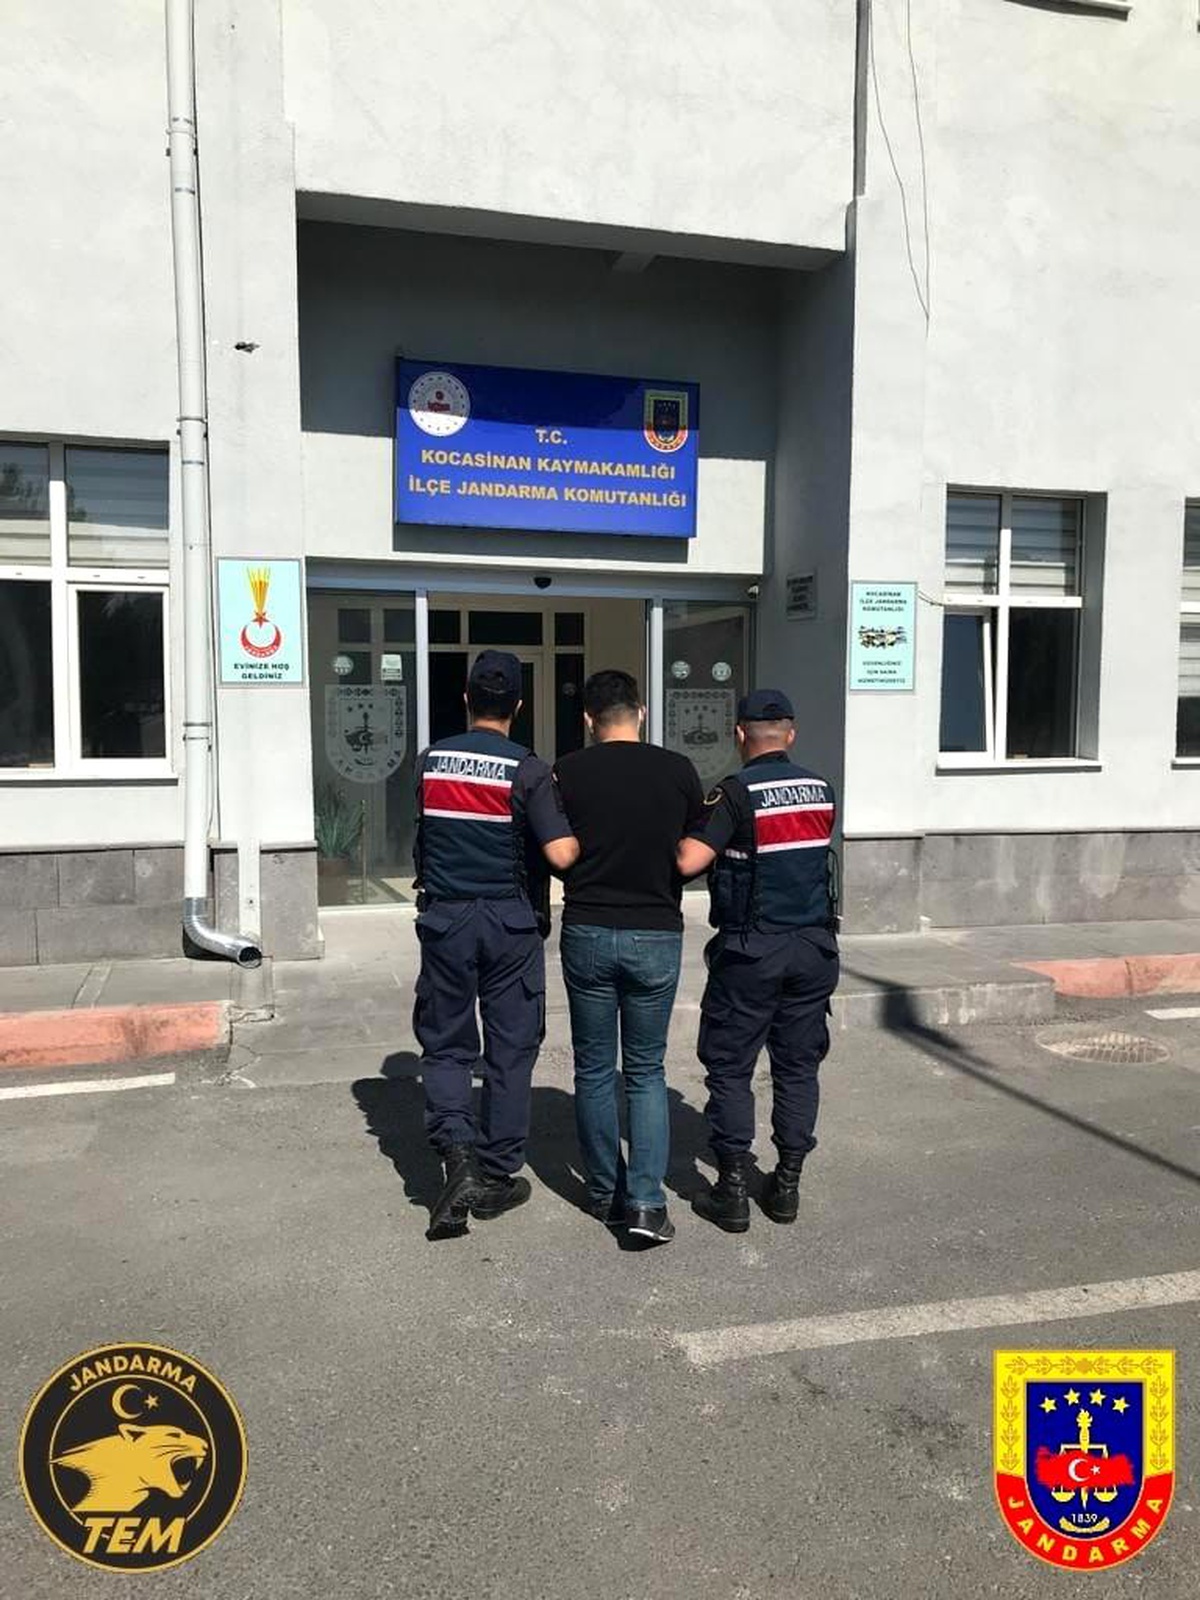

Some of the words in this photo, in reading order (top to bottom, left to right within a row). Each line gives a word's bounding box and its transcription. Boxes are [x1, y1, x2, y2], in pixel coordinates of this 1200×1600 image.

[535, 430, 568, 445] T.C.
[421, 449, 531, 471] KOCASİNAN
[537, 458, 676, 480] KAYMAKAMLIĞI
[408, 475, 451, 497] İLÇE
[457, 482, 557, 501] JANDARMA
[564, 487, 687, 507] KOMUTANLIĞI
[432, 757, 506, 780] JANDARMA
[761, 786, 826, 807] JANDARMA
